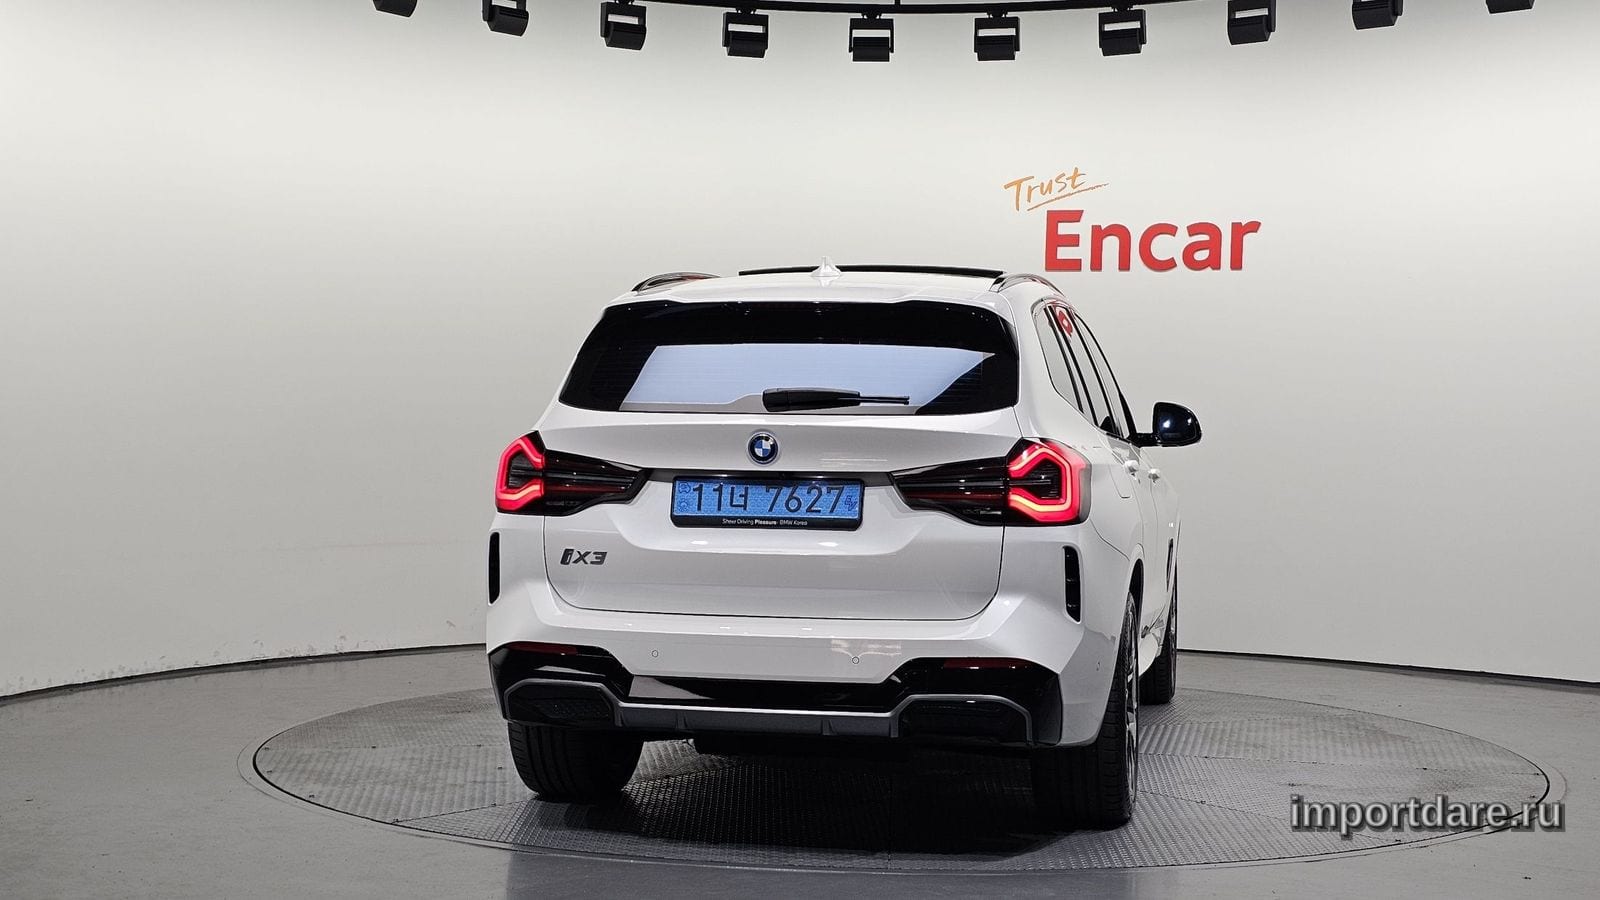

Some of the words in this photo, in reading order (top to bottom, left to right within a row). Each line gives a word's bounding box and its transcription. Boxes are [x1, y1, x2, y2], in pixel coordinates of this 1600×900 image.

[1003, 167, 1087, 211] Trust
[1045, 209, 1262, 272] Encar
[692, 483, 750, 512] 11너
[765, 485, 845, 514] 7627
[737, 518, 754, 526] Driving
